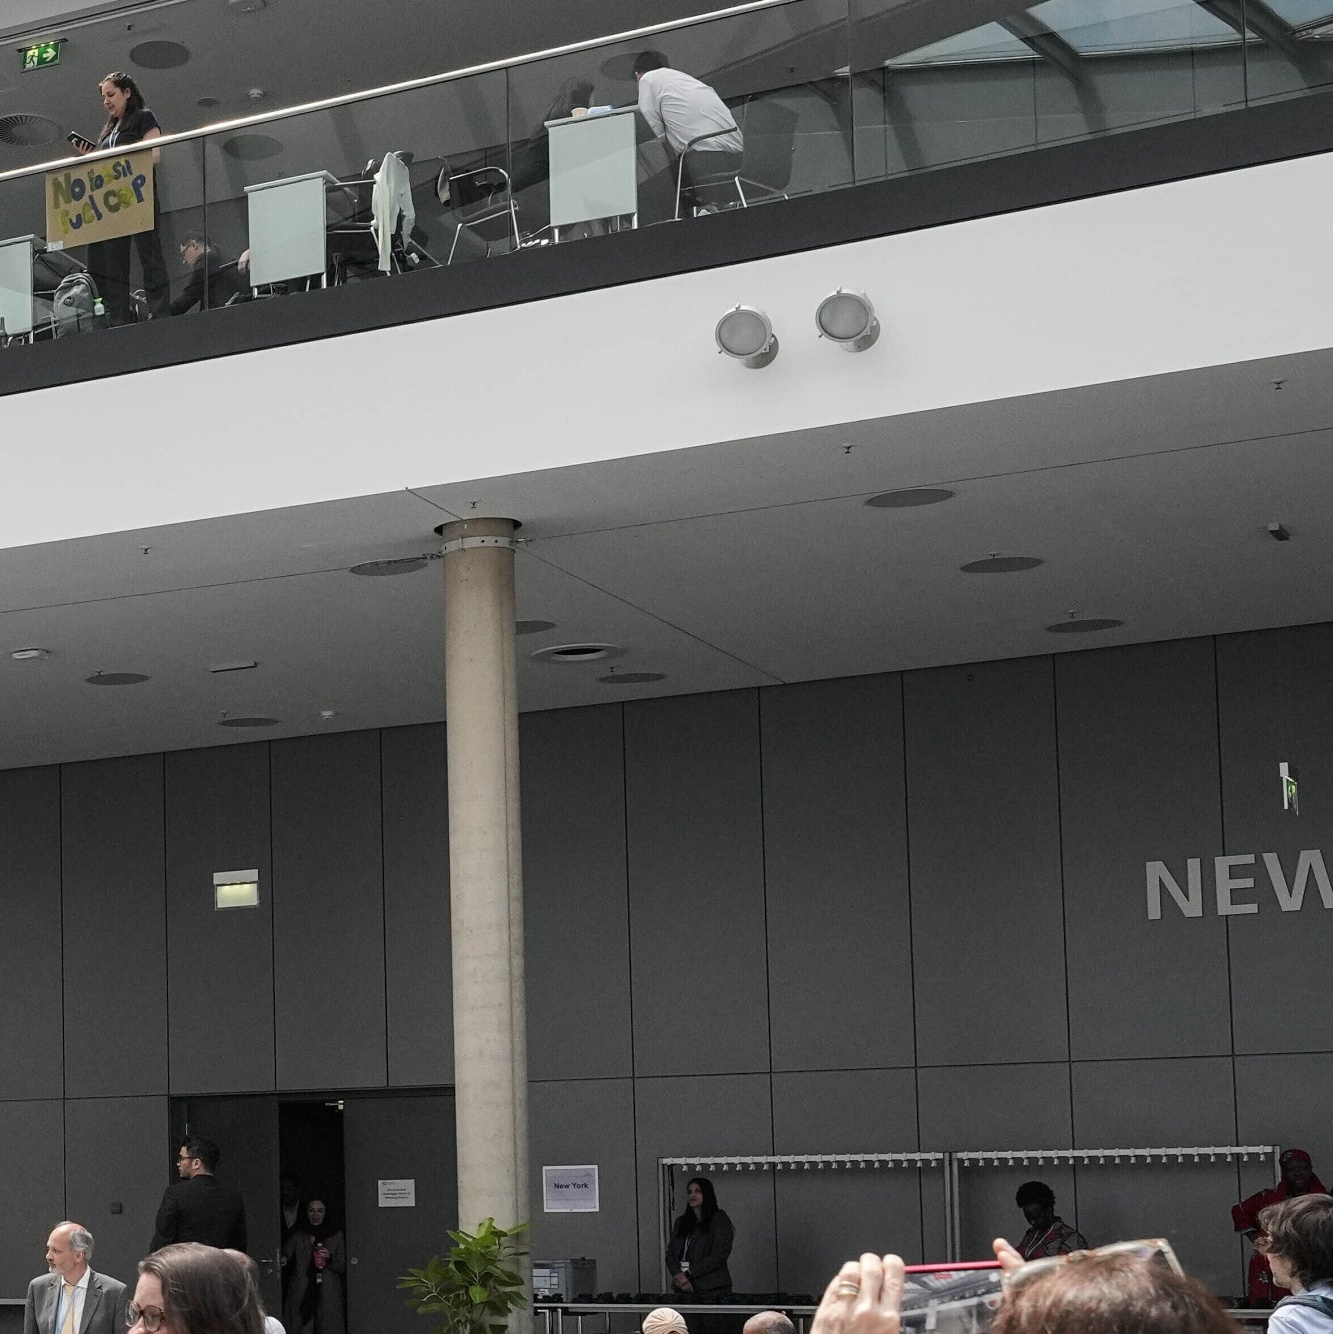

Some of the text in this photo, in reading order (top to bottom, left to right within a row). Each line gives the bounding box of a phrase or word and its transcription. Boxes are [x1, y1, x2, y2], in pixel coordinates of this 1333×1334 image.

[103, 174, 146, 213] COP
[1145, 849, 1333, 921] NEW
[554, 1182, 589, 1190] New York
